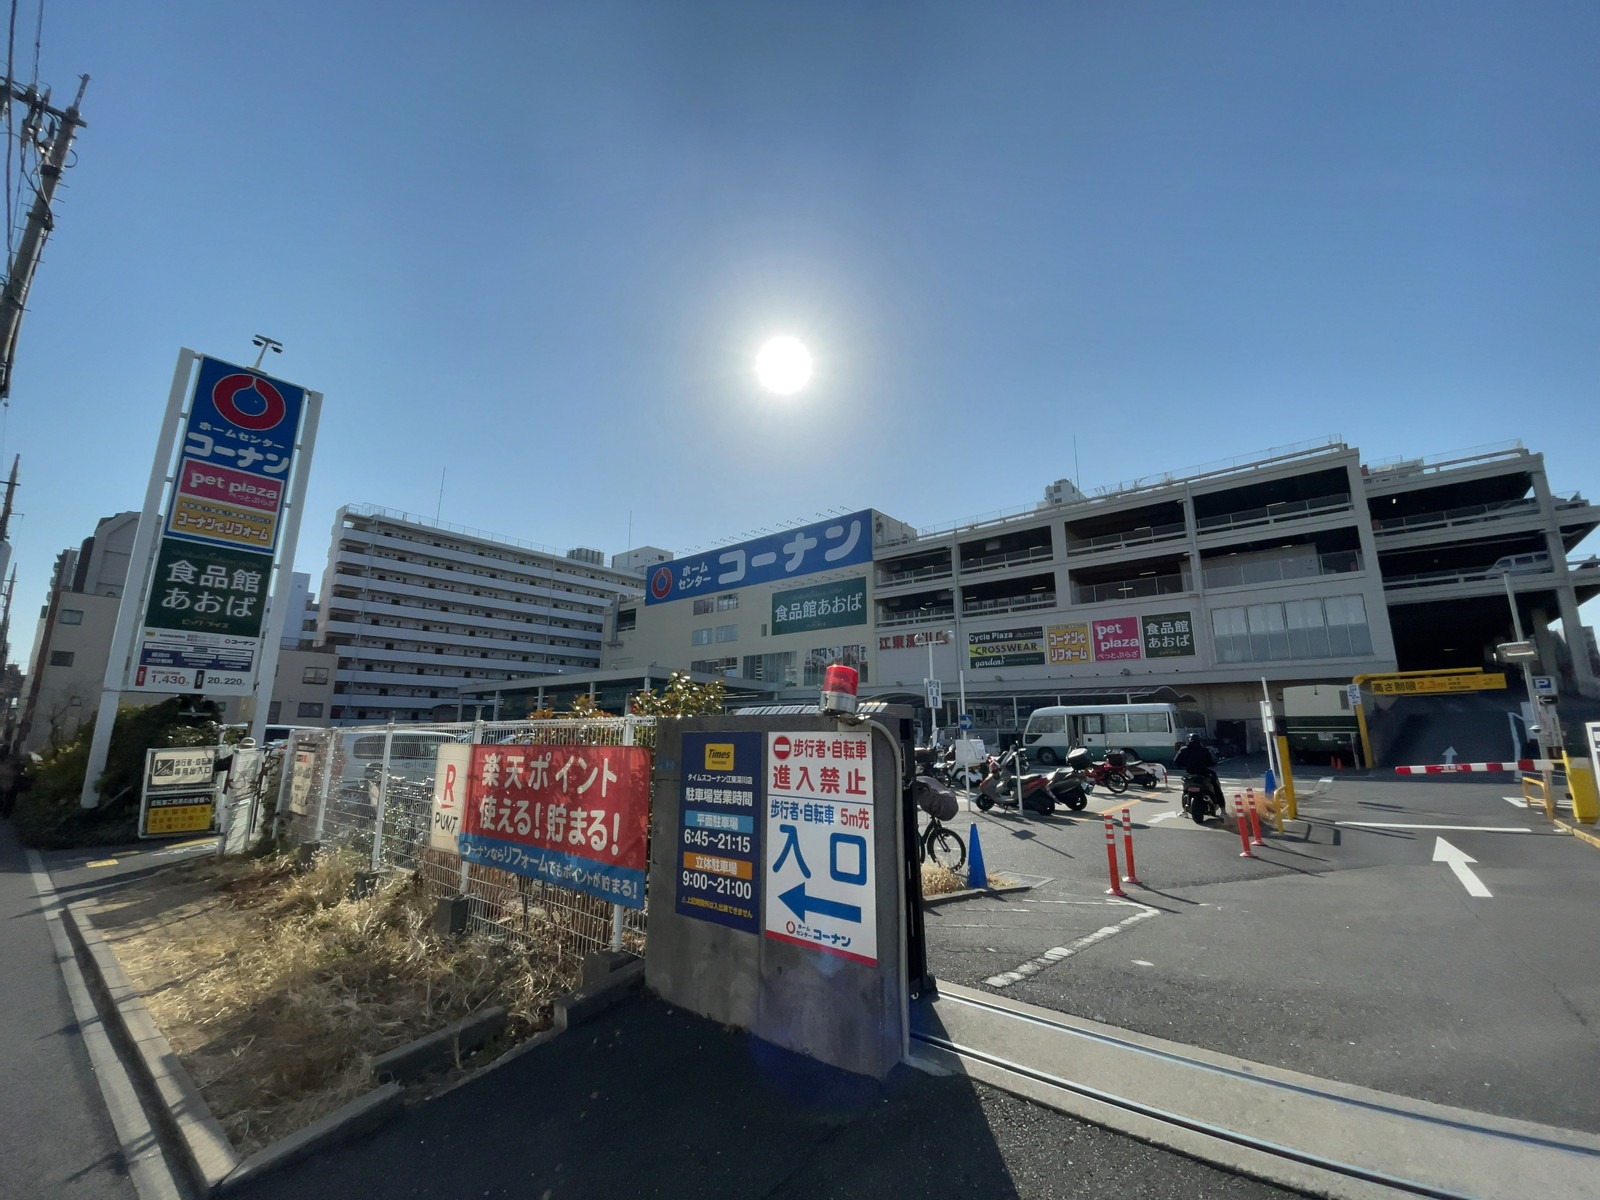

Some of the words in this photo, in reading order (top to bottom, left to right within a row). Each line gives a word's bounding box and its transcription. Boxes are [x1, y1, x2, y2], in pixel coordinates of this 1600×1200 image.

[199, 422, 284, 448] ホームセンター
[185, 432, 289, 473] コーナン
[190, 472, 225, 488] pet
[229, 482, 277, 499] plaza
[178, 512, 267, 540] コーナンでリフォーム
[718, 520, 862, 585] コーナン
[167, 560, 261, 593] 食品館
[682, 562, 708, 575] ホーム
[678, 576, 712, 590] センター
[162, 587, 256, 617] あおば
[775, 592, 863, 623] 食品館あおば
[969, 634, 990, 642] Cycle
[1097, 624, 1122, 639] pet
[1146, 620, 1189, 636] 食品館
[975, 643, 1037, 654] CROSSWEAR
[1050, 631, 1086, 646] コーナンで
[1101, 637, 1139, 650] plaza
[1148, 634, 1190, 648] あおば
[1051, 648, 1087, 661] リフォーム
[708, 749, 731, 759] Times
[794, 739, 867, 760] 歩行者・自転車
[481, 752, 617, 798] 楽天ポイント
[773, 764, 867, 795] 進入禁止
[686, 787, 753, 807] 駐車場営業時間
[697, 813, 738, 830] 平面駐車場
[770, 799, 834, 825] 歩行者・自転車
[840, 808, 870, 829] 5m先
[684, 828, 750, 853] 6:45～21:15
[772, 824, 867, 886] 入口
[695, 856, 737, 875] 立体駐車場
[682, 871, 752, 899] 9:00～21:00
[813, 929, 851, 947] コーナン
